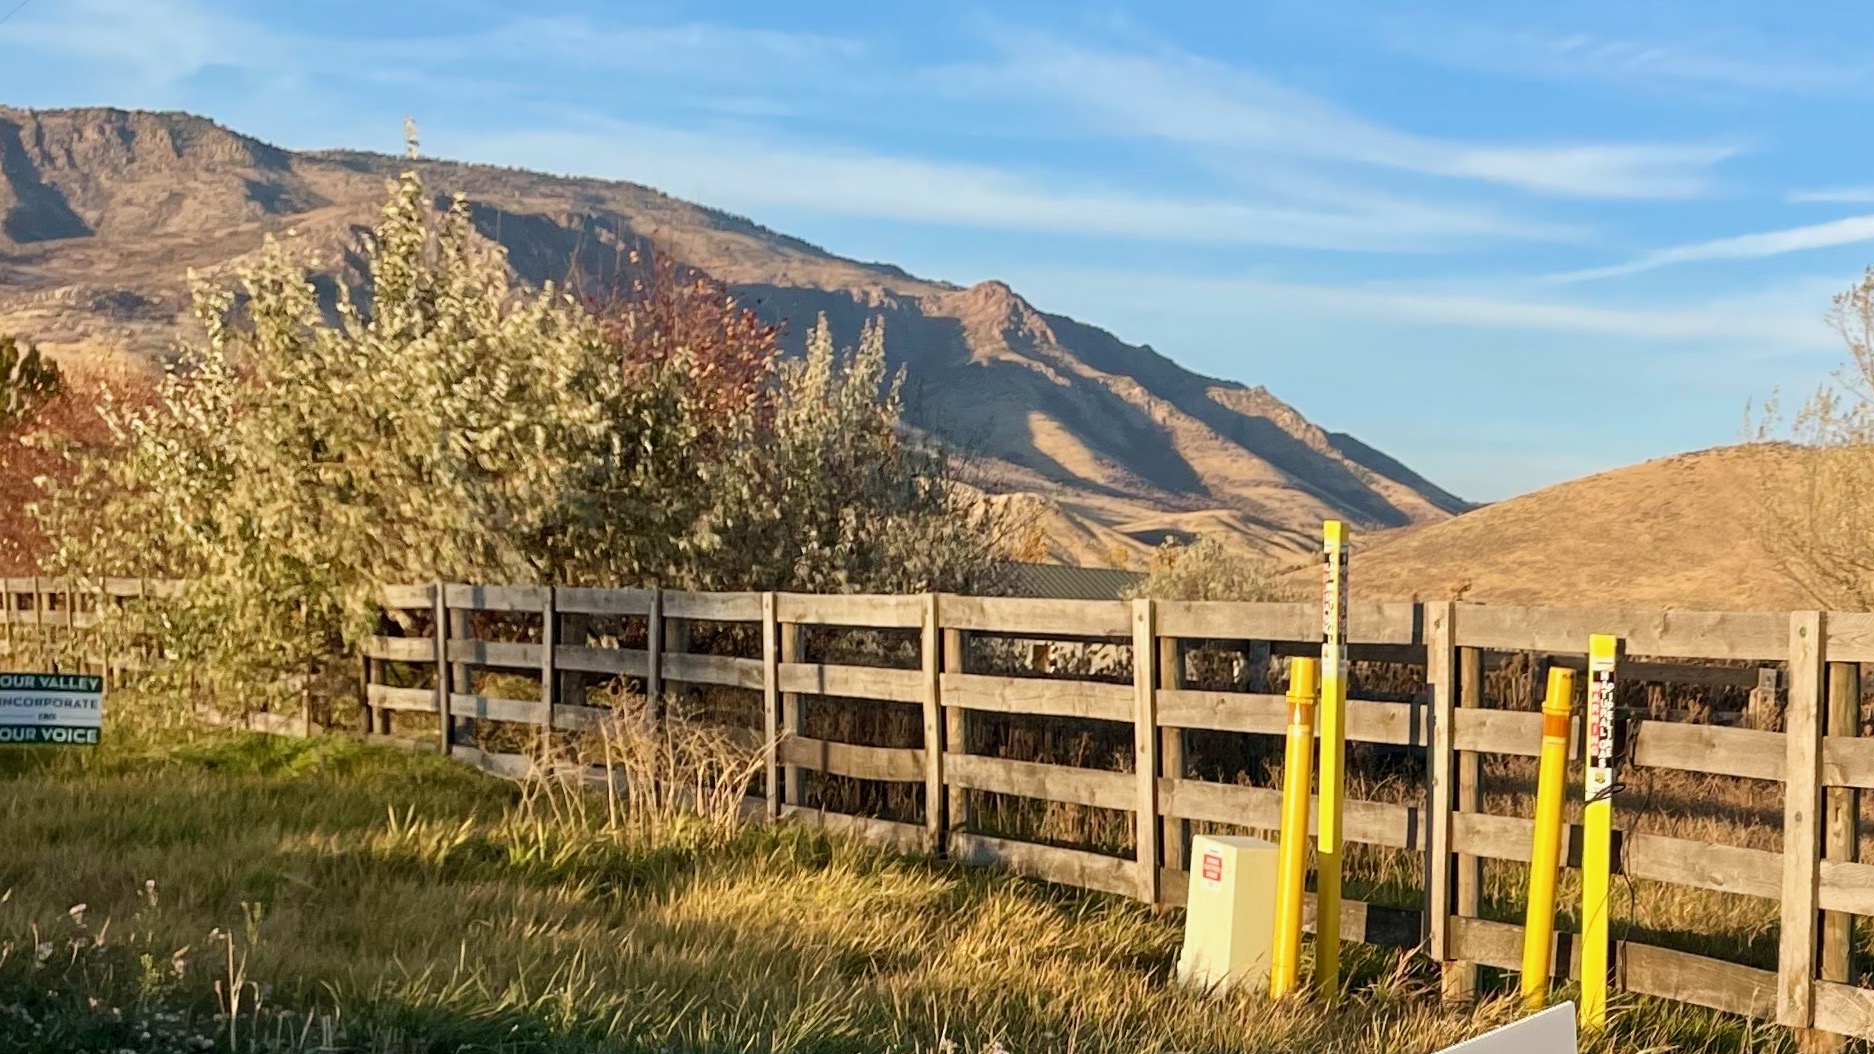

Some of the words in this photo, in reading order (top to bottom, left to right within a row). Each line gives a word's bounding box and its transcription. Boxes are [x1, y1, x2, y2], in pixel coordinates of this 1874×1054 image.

[0, 675, 36, 688] OUR
[39, 677, 99, 691] VALLEY
[1599, 671, 1610, 737] NATURAL
[0, 727, 37, 741] OUR
[41, 728, 98, 744] VOICE
[1598, 739, 1608, 768] GAS
